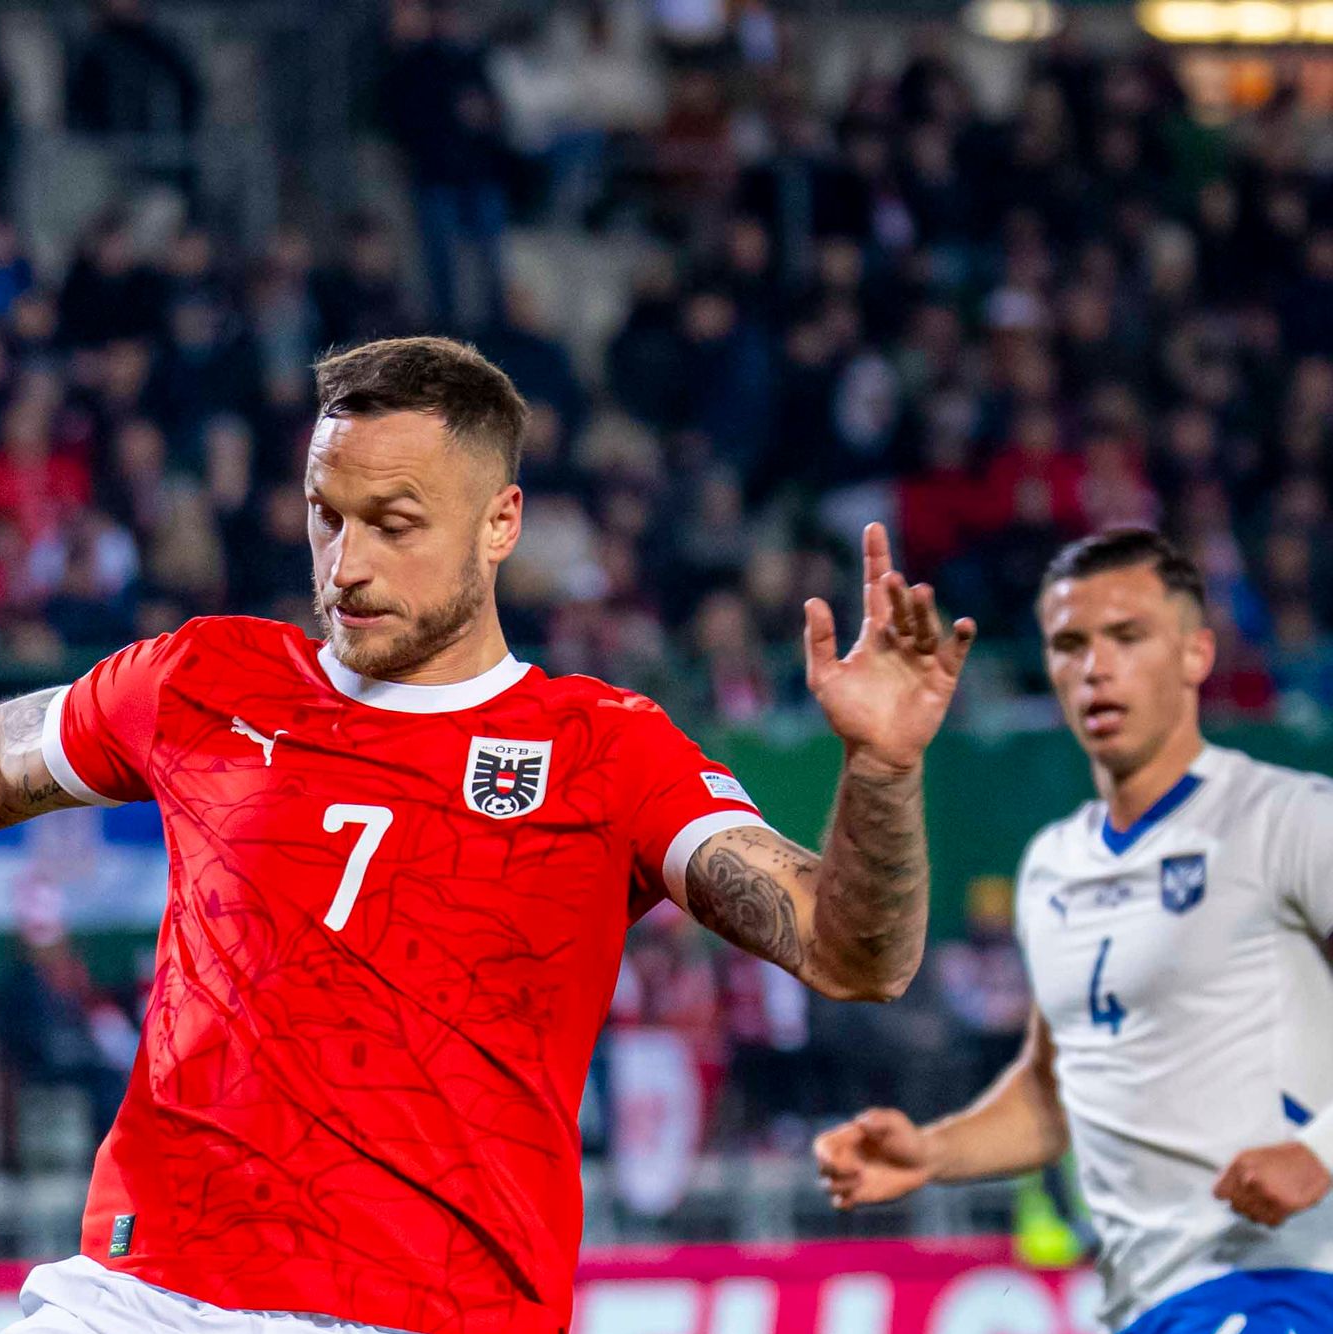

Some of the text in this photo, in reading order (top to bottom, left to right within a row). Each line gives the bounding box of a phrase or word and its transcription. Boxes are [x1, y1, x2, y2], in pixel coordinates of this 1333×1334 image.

[495, 745, 530, 756] ÖFB
[322, 803, 394, 932] 7
[1088, 936, 1127, 1036] 4
